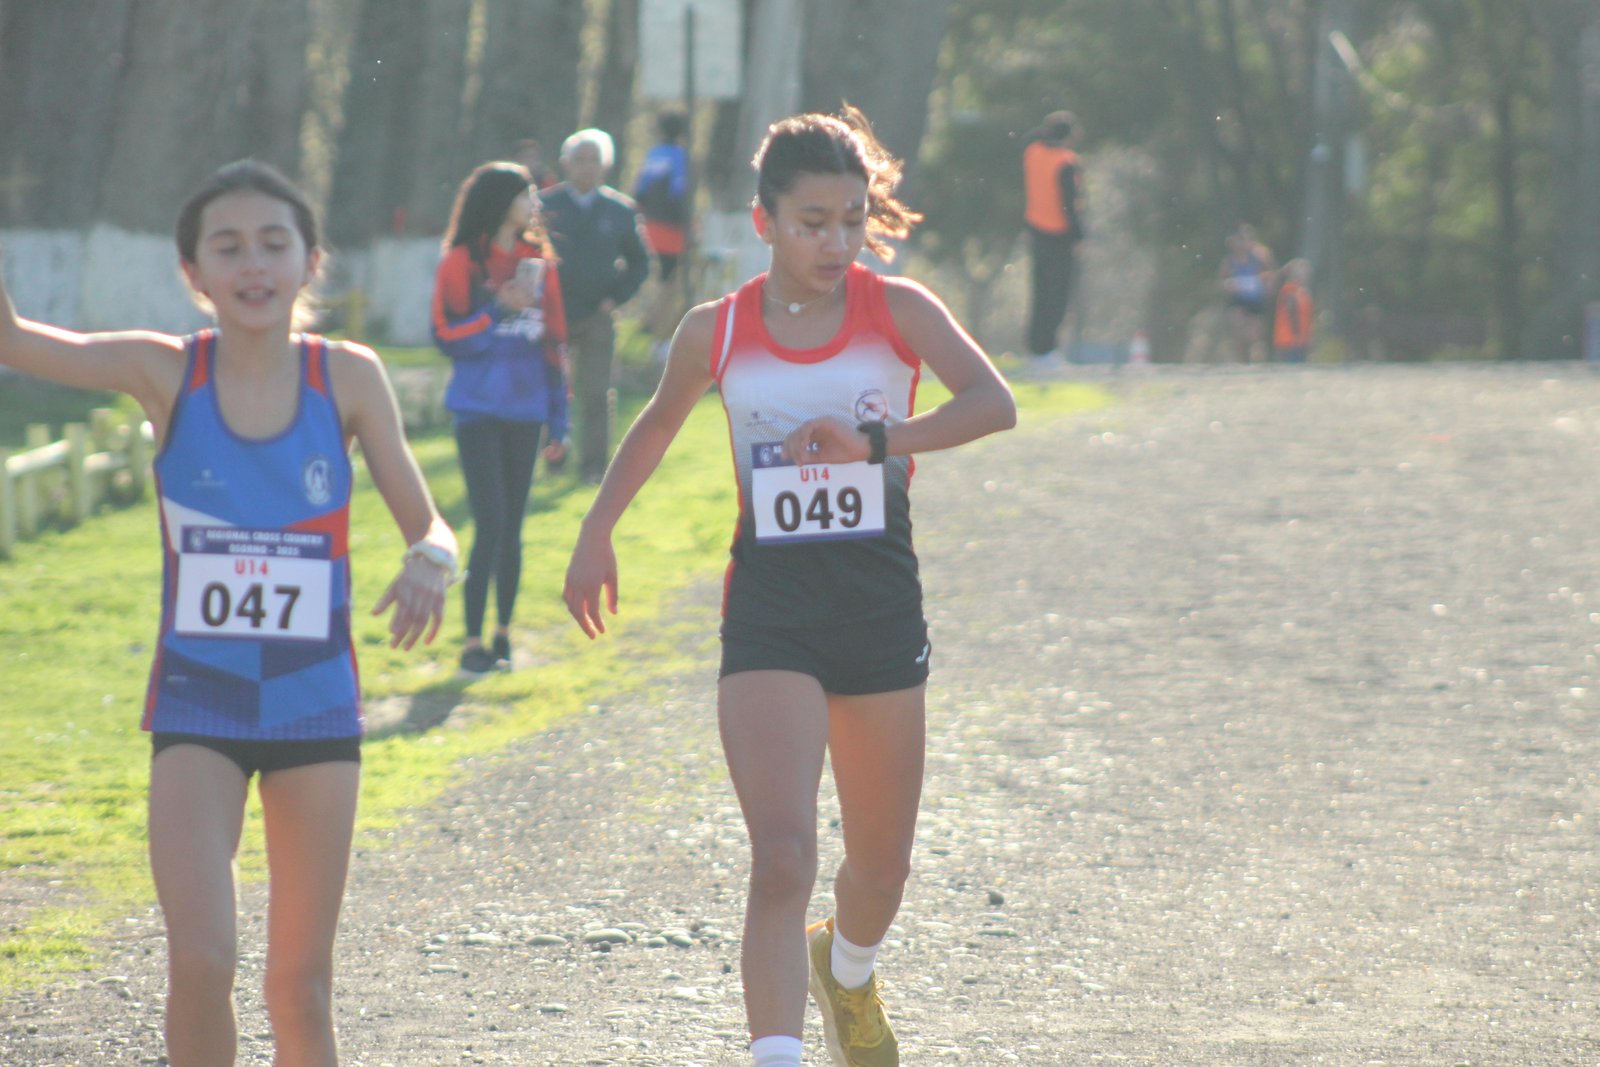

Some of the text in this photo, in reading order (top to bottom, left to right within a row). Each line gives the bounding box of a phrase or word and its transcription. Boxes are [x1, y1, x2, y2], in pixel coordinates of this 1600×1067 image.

[800, 467, 830, 482] U14
[773, 486, 863, 532] 049
[206, 529, 324, 546] REGIONAL CROSS COUNTRY
[234, 558, 269, 576] U14
[201, 581, 302, 630] 047
